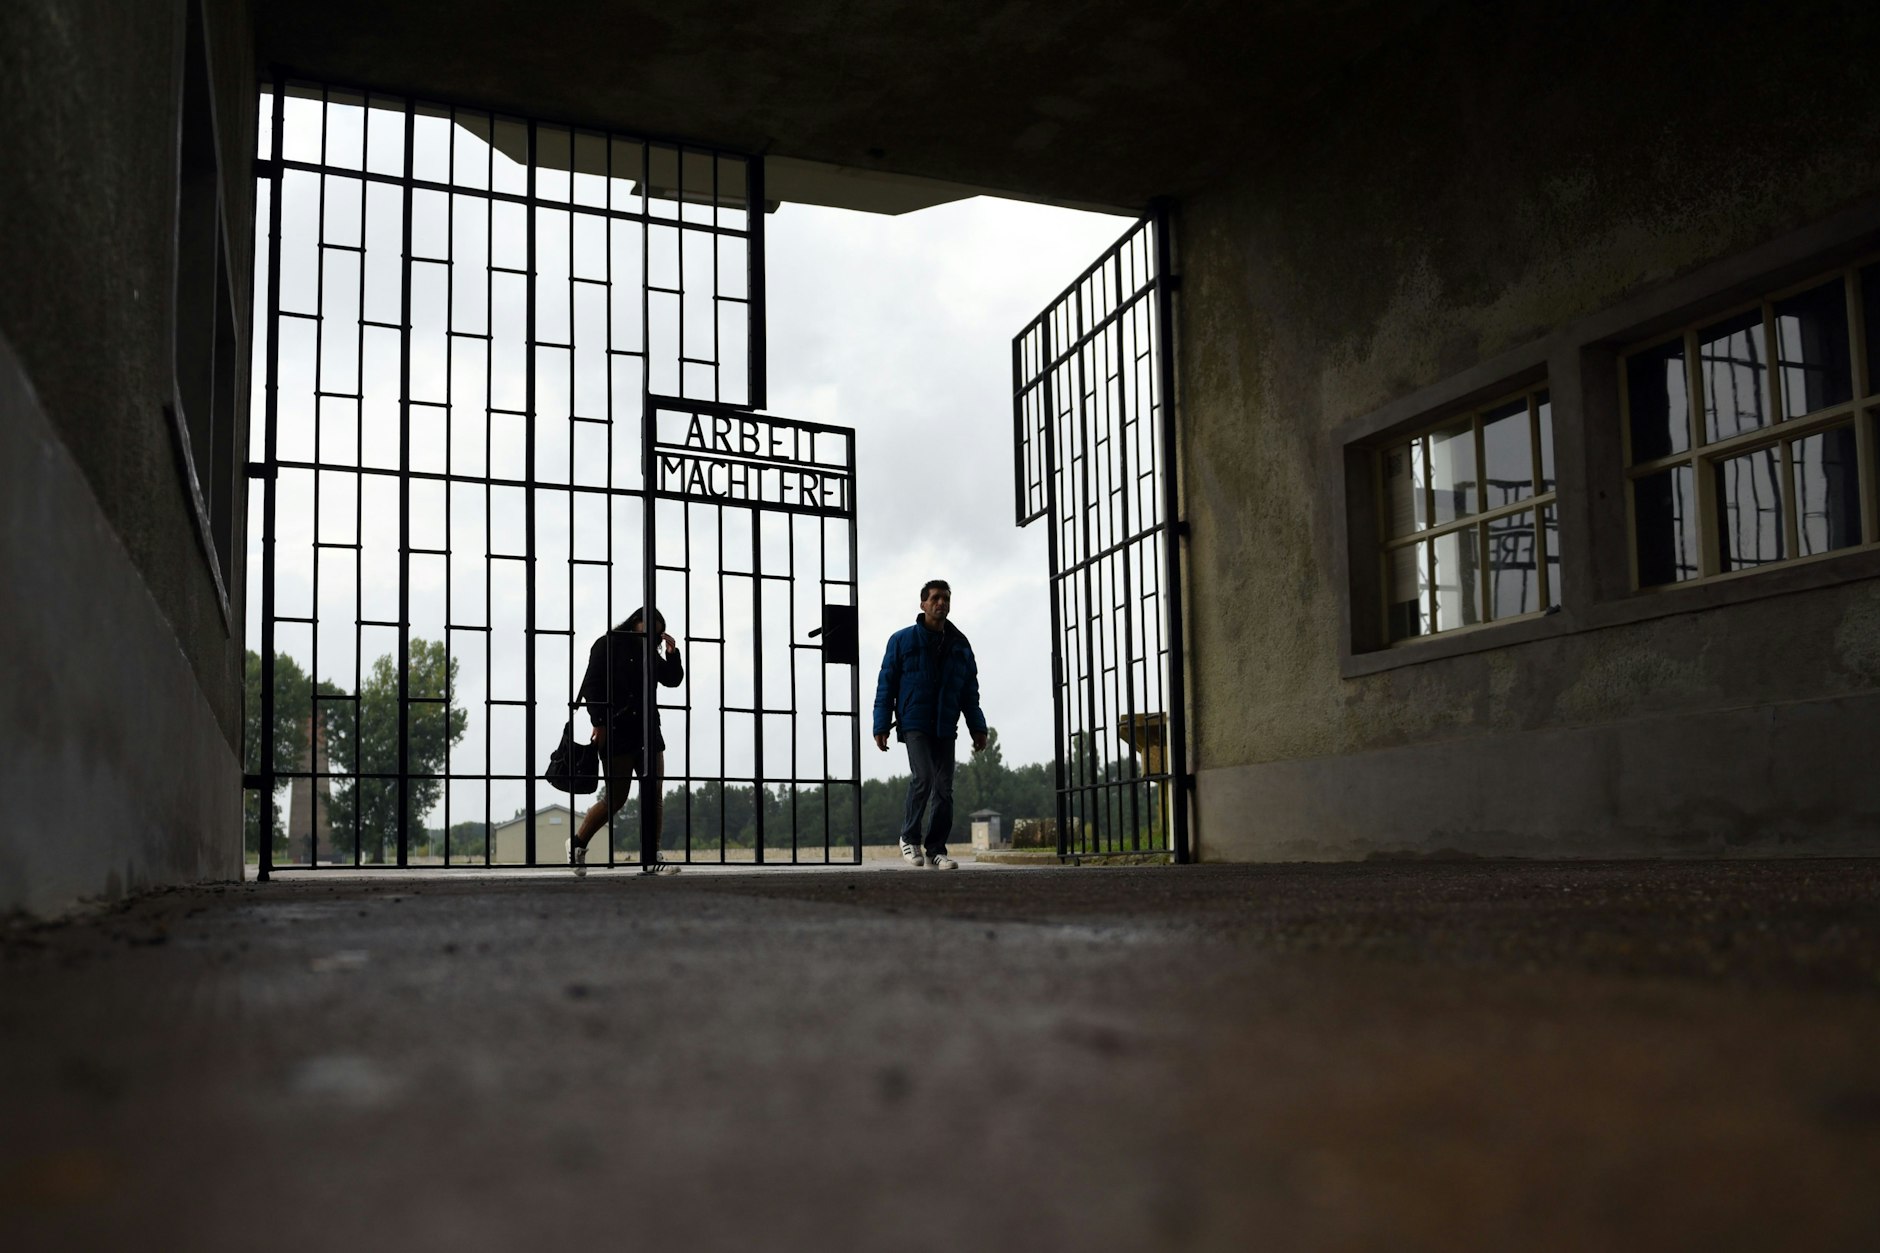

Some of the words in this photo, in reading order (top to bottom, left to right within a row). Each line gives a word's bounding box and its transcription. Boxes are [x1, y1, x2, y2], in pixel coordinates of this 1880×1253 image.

[685, 414, 823, 464] ARBEIT
[661, 456, 771, 501] MACHT
[780, 470, 845, 511] FREI
